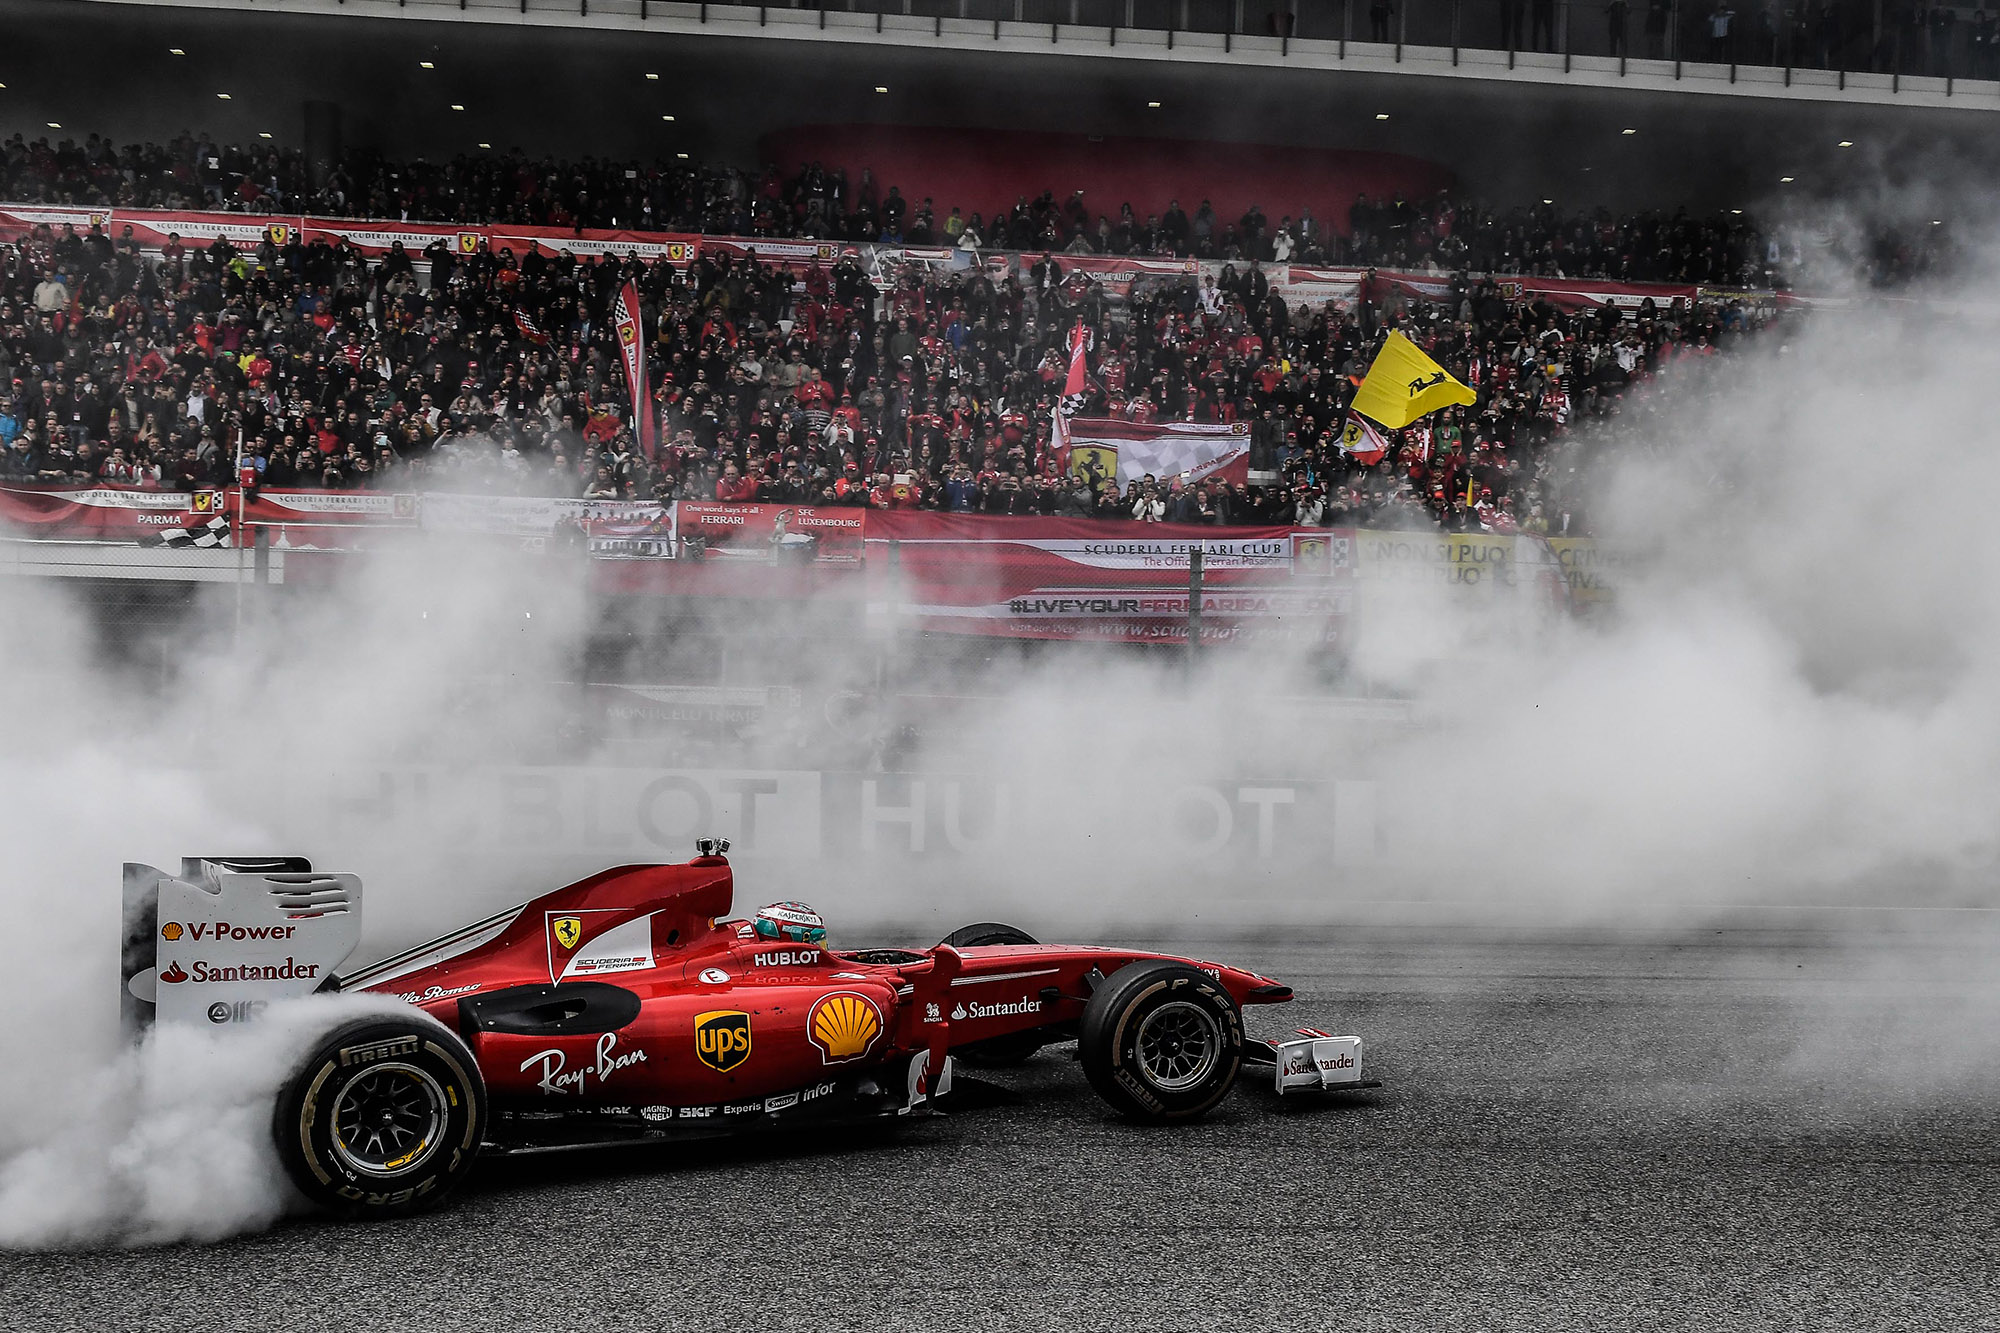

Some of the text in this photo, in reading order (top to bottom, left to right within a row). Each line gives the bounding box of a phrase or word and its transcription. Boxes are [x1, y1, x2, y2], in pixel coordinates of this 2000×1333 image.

[685, 504, 701, 512] One
[703, 505, 722, 513] word
[724, 507, 740, 515] says
[750, 506, 759, 514] all
[798, 508, 815, 517] SFC
[137, 514, 182, 525] PARMA
[701, 515, 744, 525] FERRARI
[798, 518, 861, 527] LUXEMBOURG
[1084, 544, 1162, 555] SCUDERIA
[1241, 544, 1282, 554] CLUB
[1143, 556, 1281, 567] The Offic Ferrari Passion
[860, 779, 1296, 858] HUOT
[187, 922, 296, 941] V-Power
[576, 956, 632, 967] SCUDERIA
[754, 950, 820, 967] HUBLOT
[191, 956, 320, 983] Santander
[597, 961, 645, 970] FERRARI
[423, 982, 482, 1000] Romeo
[968, 995, 1042, 1019] Santander
[1171, 978, 1189, 990] P
[1196, 983, 1241, 1047] ZERO
[340, 1035, 419, 1067] PIRELLI
[700, 1027, 747, 1063] ups
[803, 1081, 836, 1102] infor
[600, 1106, 632, 1115] NGK
[679, 1106, 717, 1118] SKF
[723, 1102, 762, 1115] Experis
